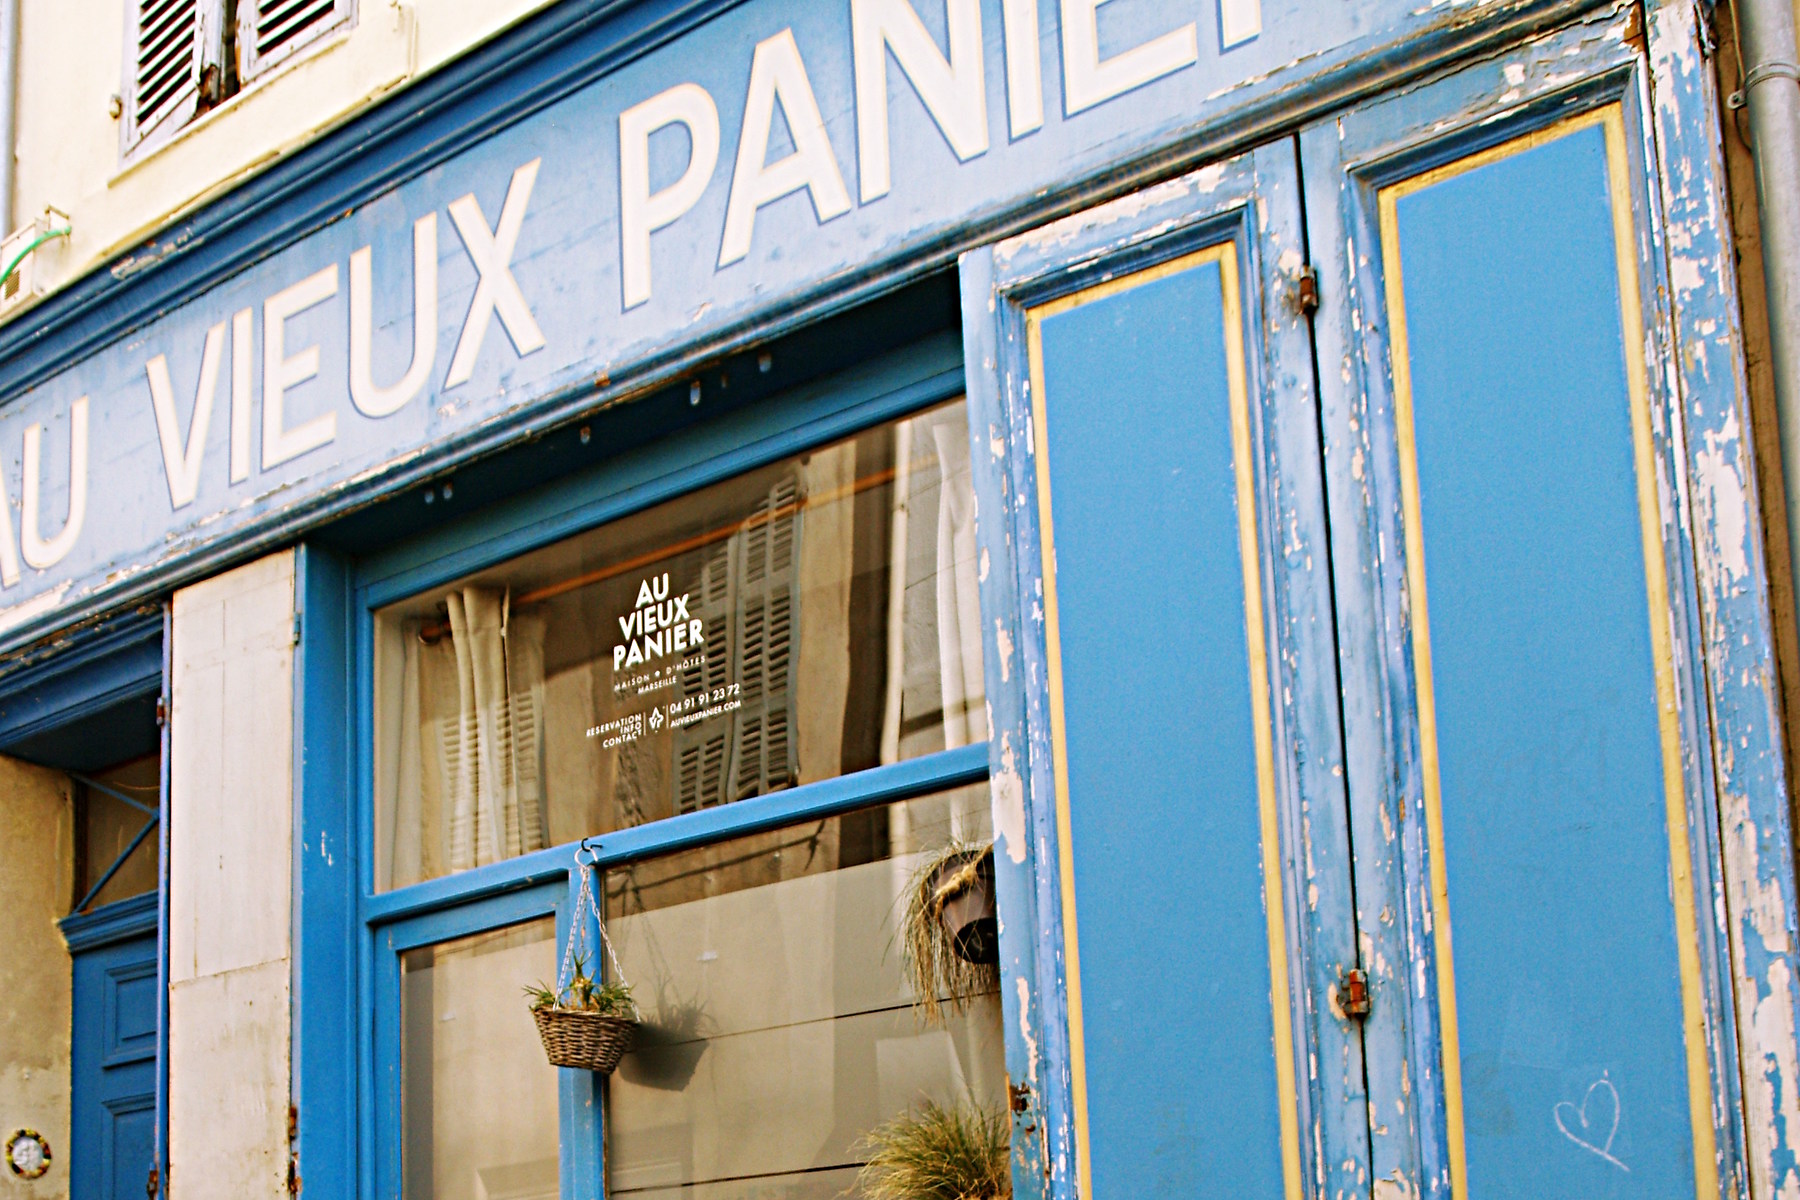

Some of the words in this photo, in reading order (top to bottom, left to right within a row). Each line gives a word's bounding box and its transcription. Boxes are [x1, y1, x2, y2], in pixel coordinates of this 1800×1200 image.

[145, 157, 546, 511] VIEUX
[635, 572, 669, 608] AU
[618, 593, 690, 641] VIEUX
[613, 618, 704, 671] PANIER
[614, 674, 650, 692] MAISON
[637, 675, 677, 695] MARSEILLE
[602, 730, 642, 748] CONTACT
[619, 722, 642, 734] INFO
